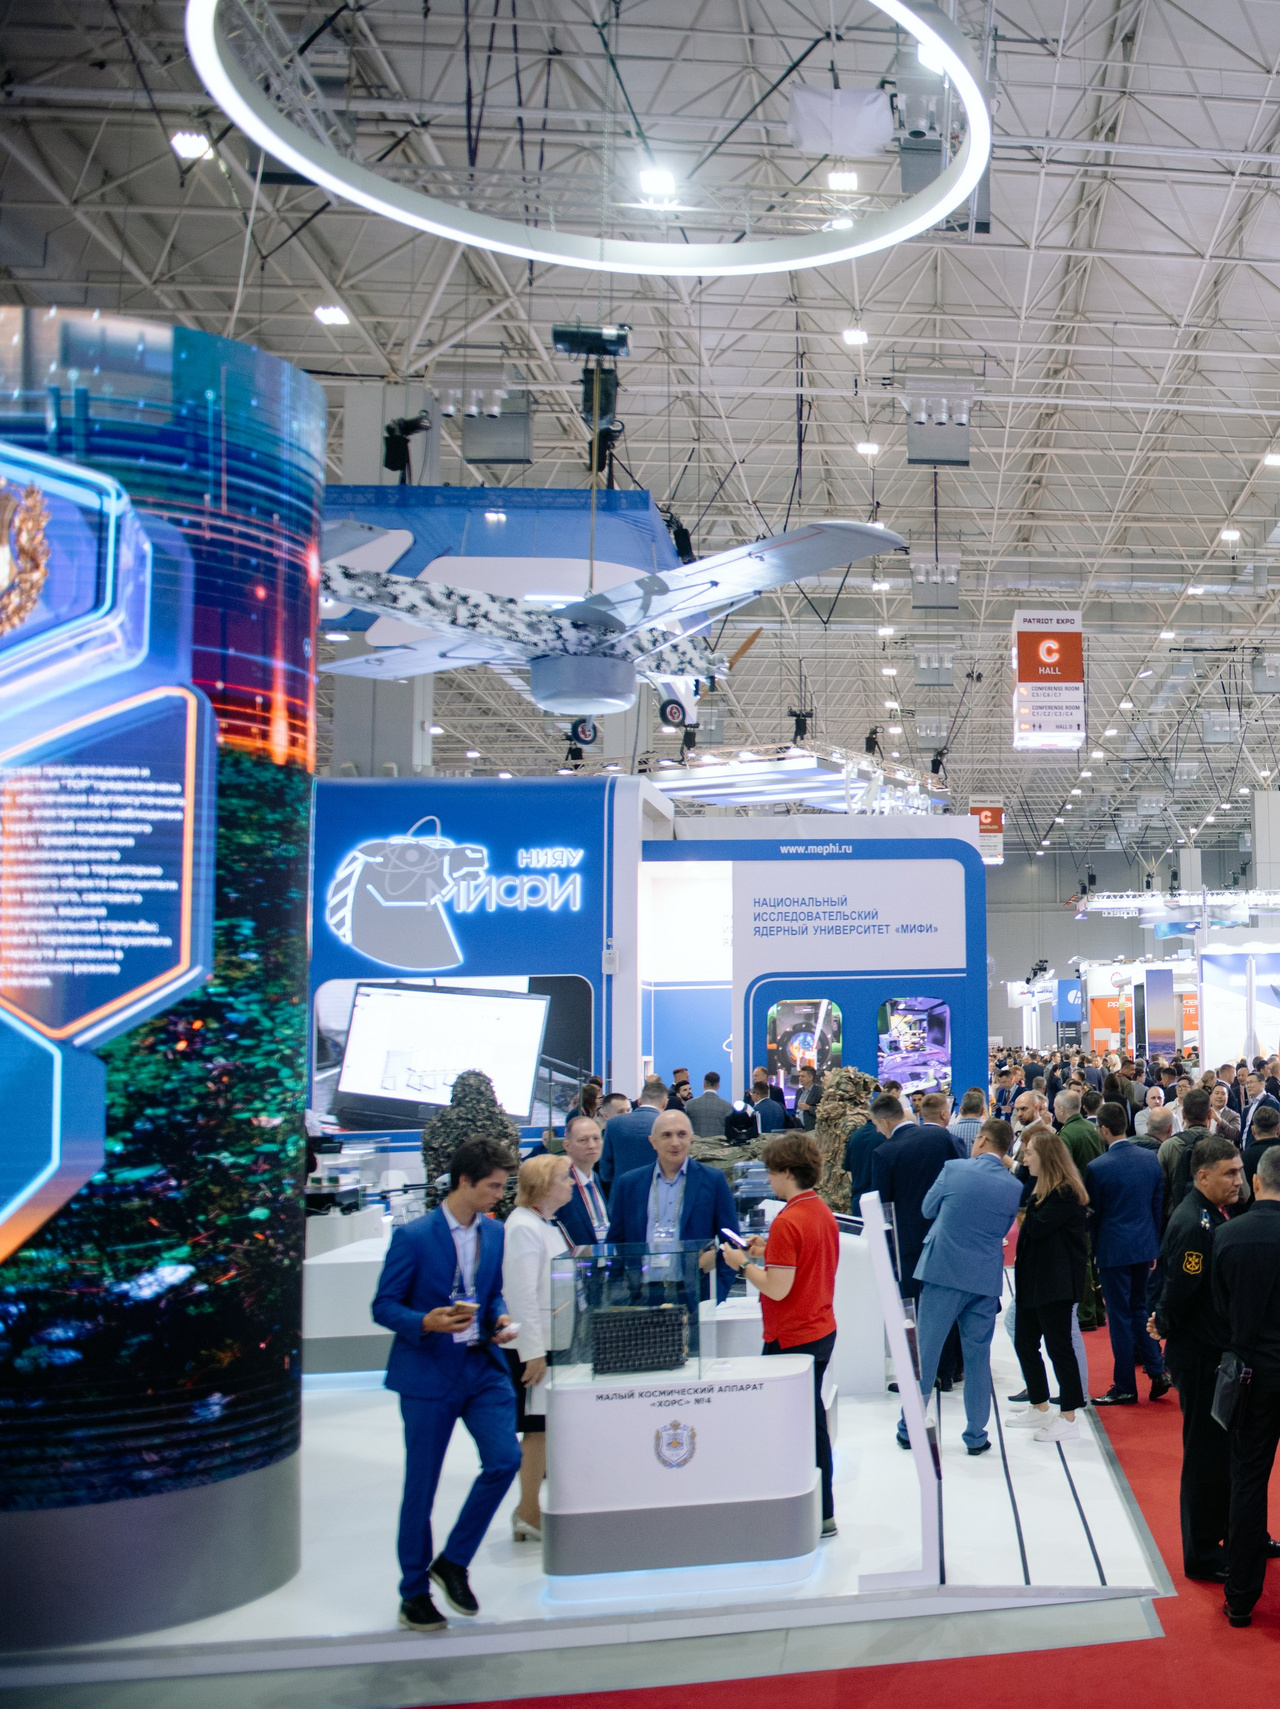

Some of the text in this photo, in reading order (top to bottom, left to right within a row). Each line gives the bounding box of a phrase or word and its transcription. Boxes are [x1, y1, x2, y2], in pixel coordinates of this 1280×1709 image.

[1023, 617, 1053, 625] PATRIOT
[1039, 639, 1060, 663] C
[1038, 666, 1061, 675] HALL
[780, 843, 853, 856] www.mephi.ru
[518, 848, 584, 868] НИЯУ
[753, 895, 848, 908] НАЦИОНАЛЬНЫЙ
[753, 909, 879, 922] ИССЛЕДОВАТЕЛЬСКИЙ
[753, 923, 938, 937] ЯДЕРНЫЙ УНИВЕРСИТЕТ «МИФИ»
[595, 1382, 764, 1402] МАЛЫЙ КОСМИЧЕСКИЙ АППАРАТ
[651, 1398, 690, 1408] «ХОРС»
